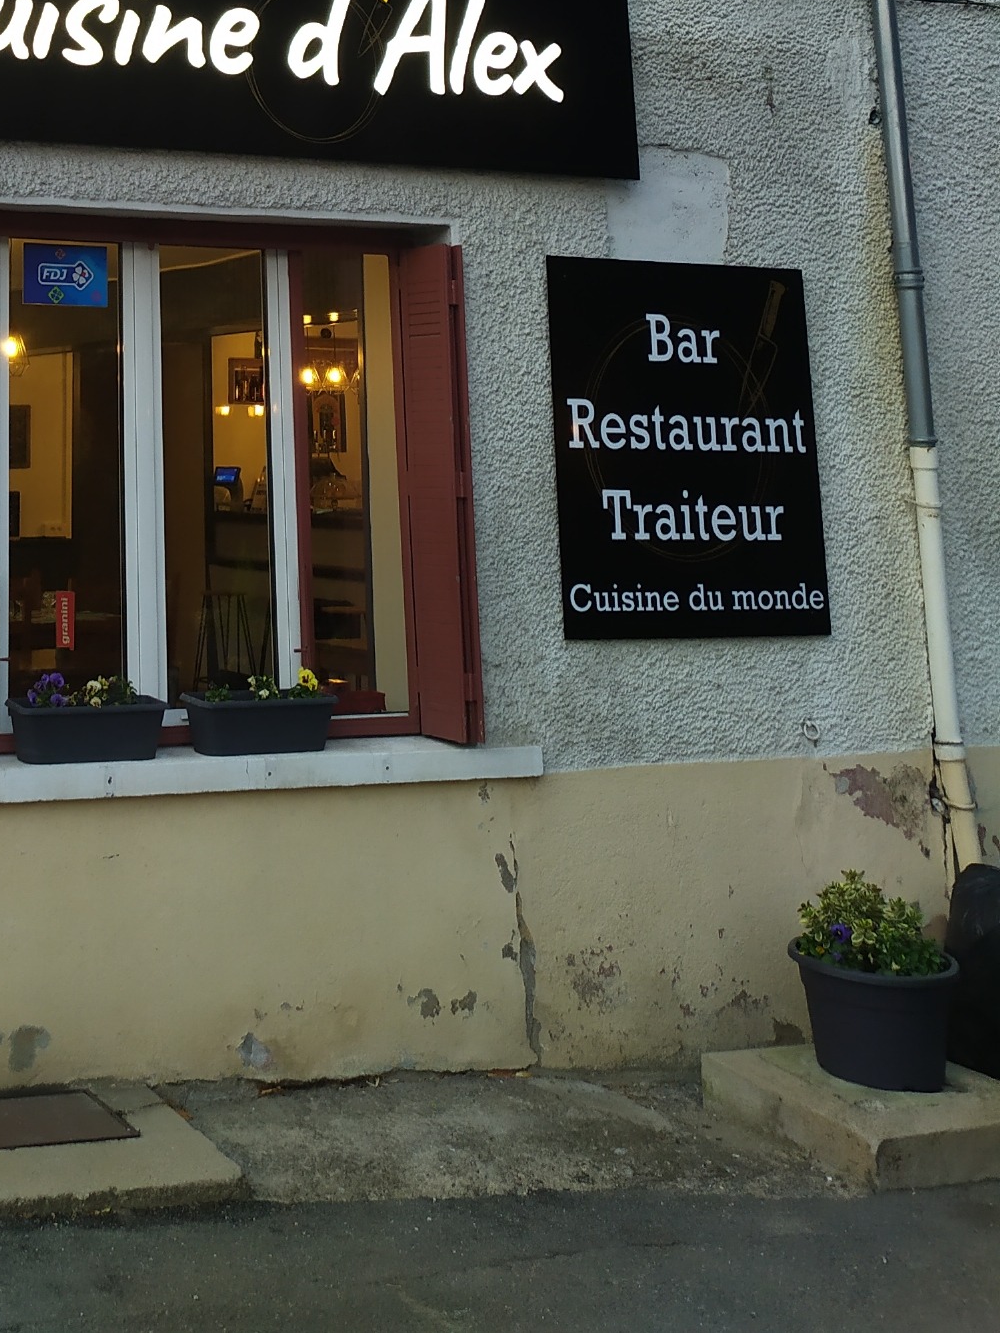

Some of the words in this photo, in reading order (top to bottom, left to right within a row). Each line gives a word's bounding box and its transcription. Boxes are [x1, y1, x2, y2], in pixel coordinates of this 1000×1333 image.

[42, 268, 68, 281] FDJ
[645, 312, 720, 364] Bar
[566, 397, 806, 454] Restaurant
[601, 489, 785, 541] Traiteur
[60, 597, 70, 644] granini
[569, 582, 680, 613] Cuisine
[688, 583, 725, 612] du
[730, 581, 825, 611] monde
